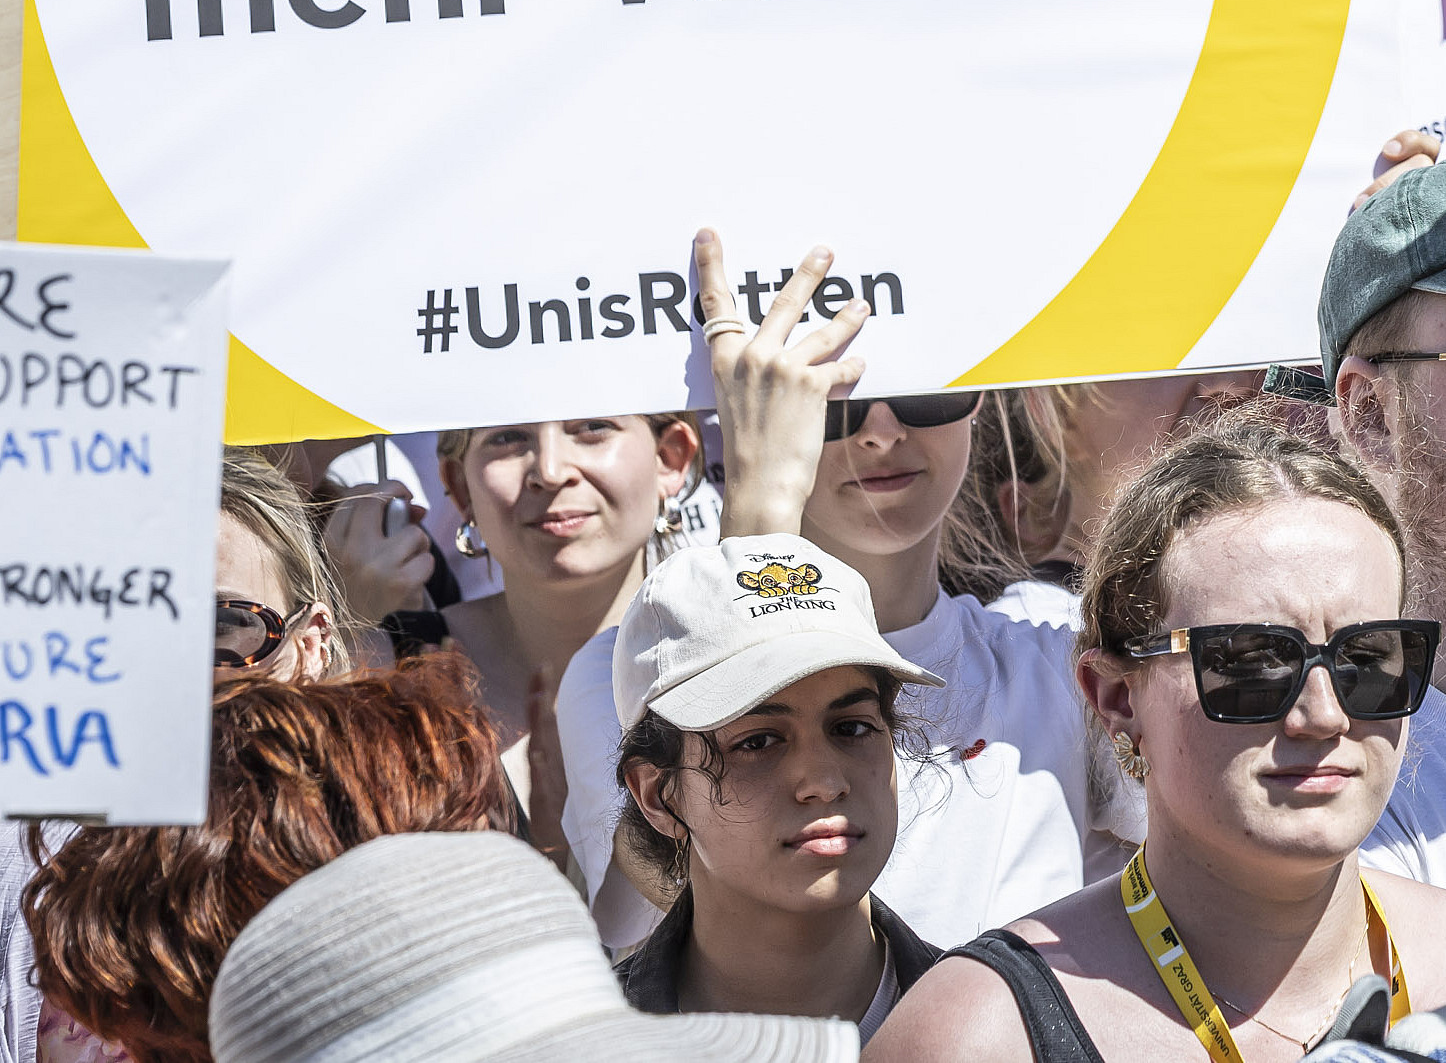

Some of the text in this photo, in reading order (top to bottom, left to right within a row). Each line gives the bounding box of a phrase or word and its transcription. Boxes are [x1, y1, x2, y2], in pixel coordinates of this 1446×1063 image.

[748, 598, 837, 619] LION KING
[779, 596, 799, 604] THE
[1172, 962, 1194, 992] GRAZ
[1188, 994, 1231, 1058] UNIVERSITÄT
